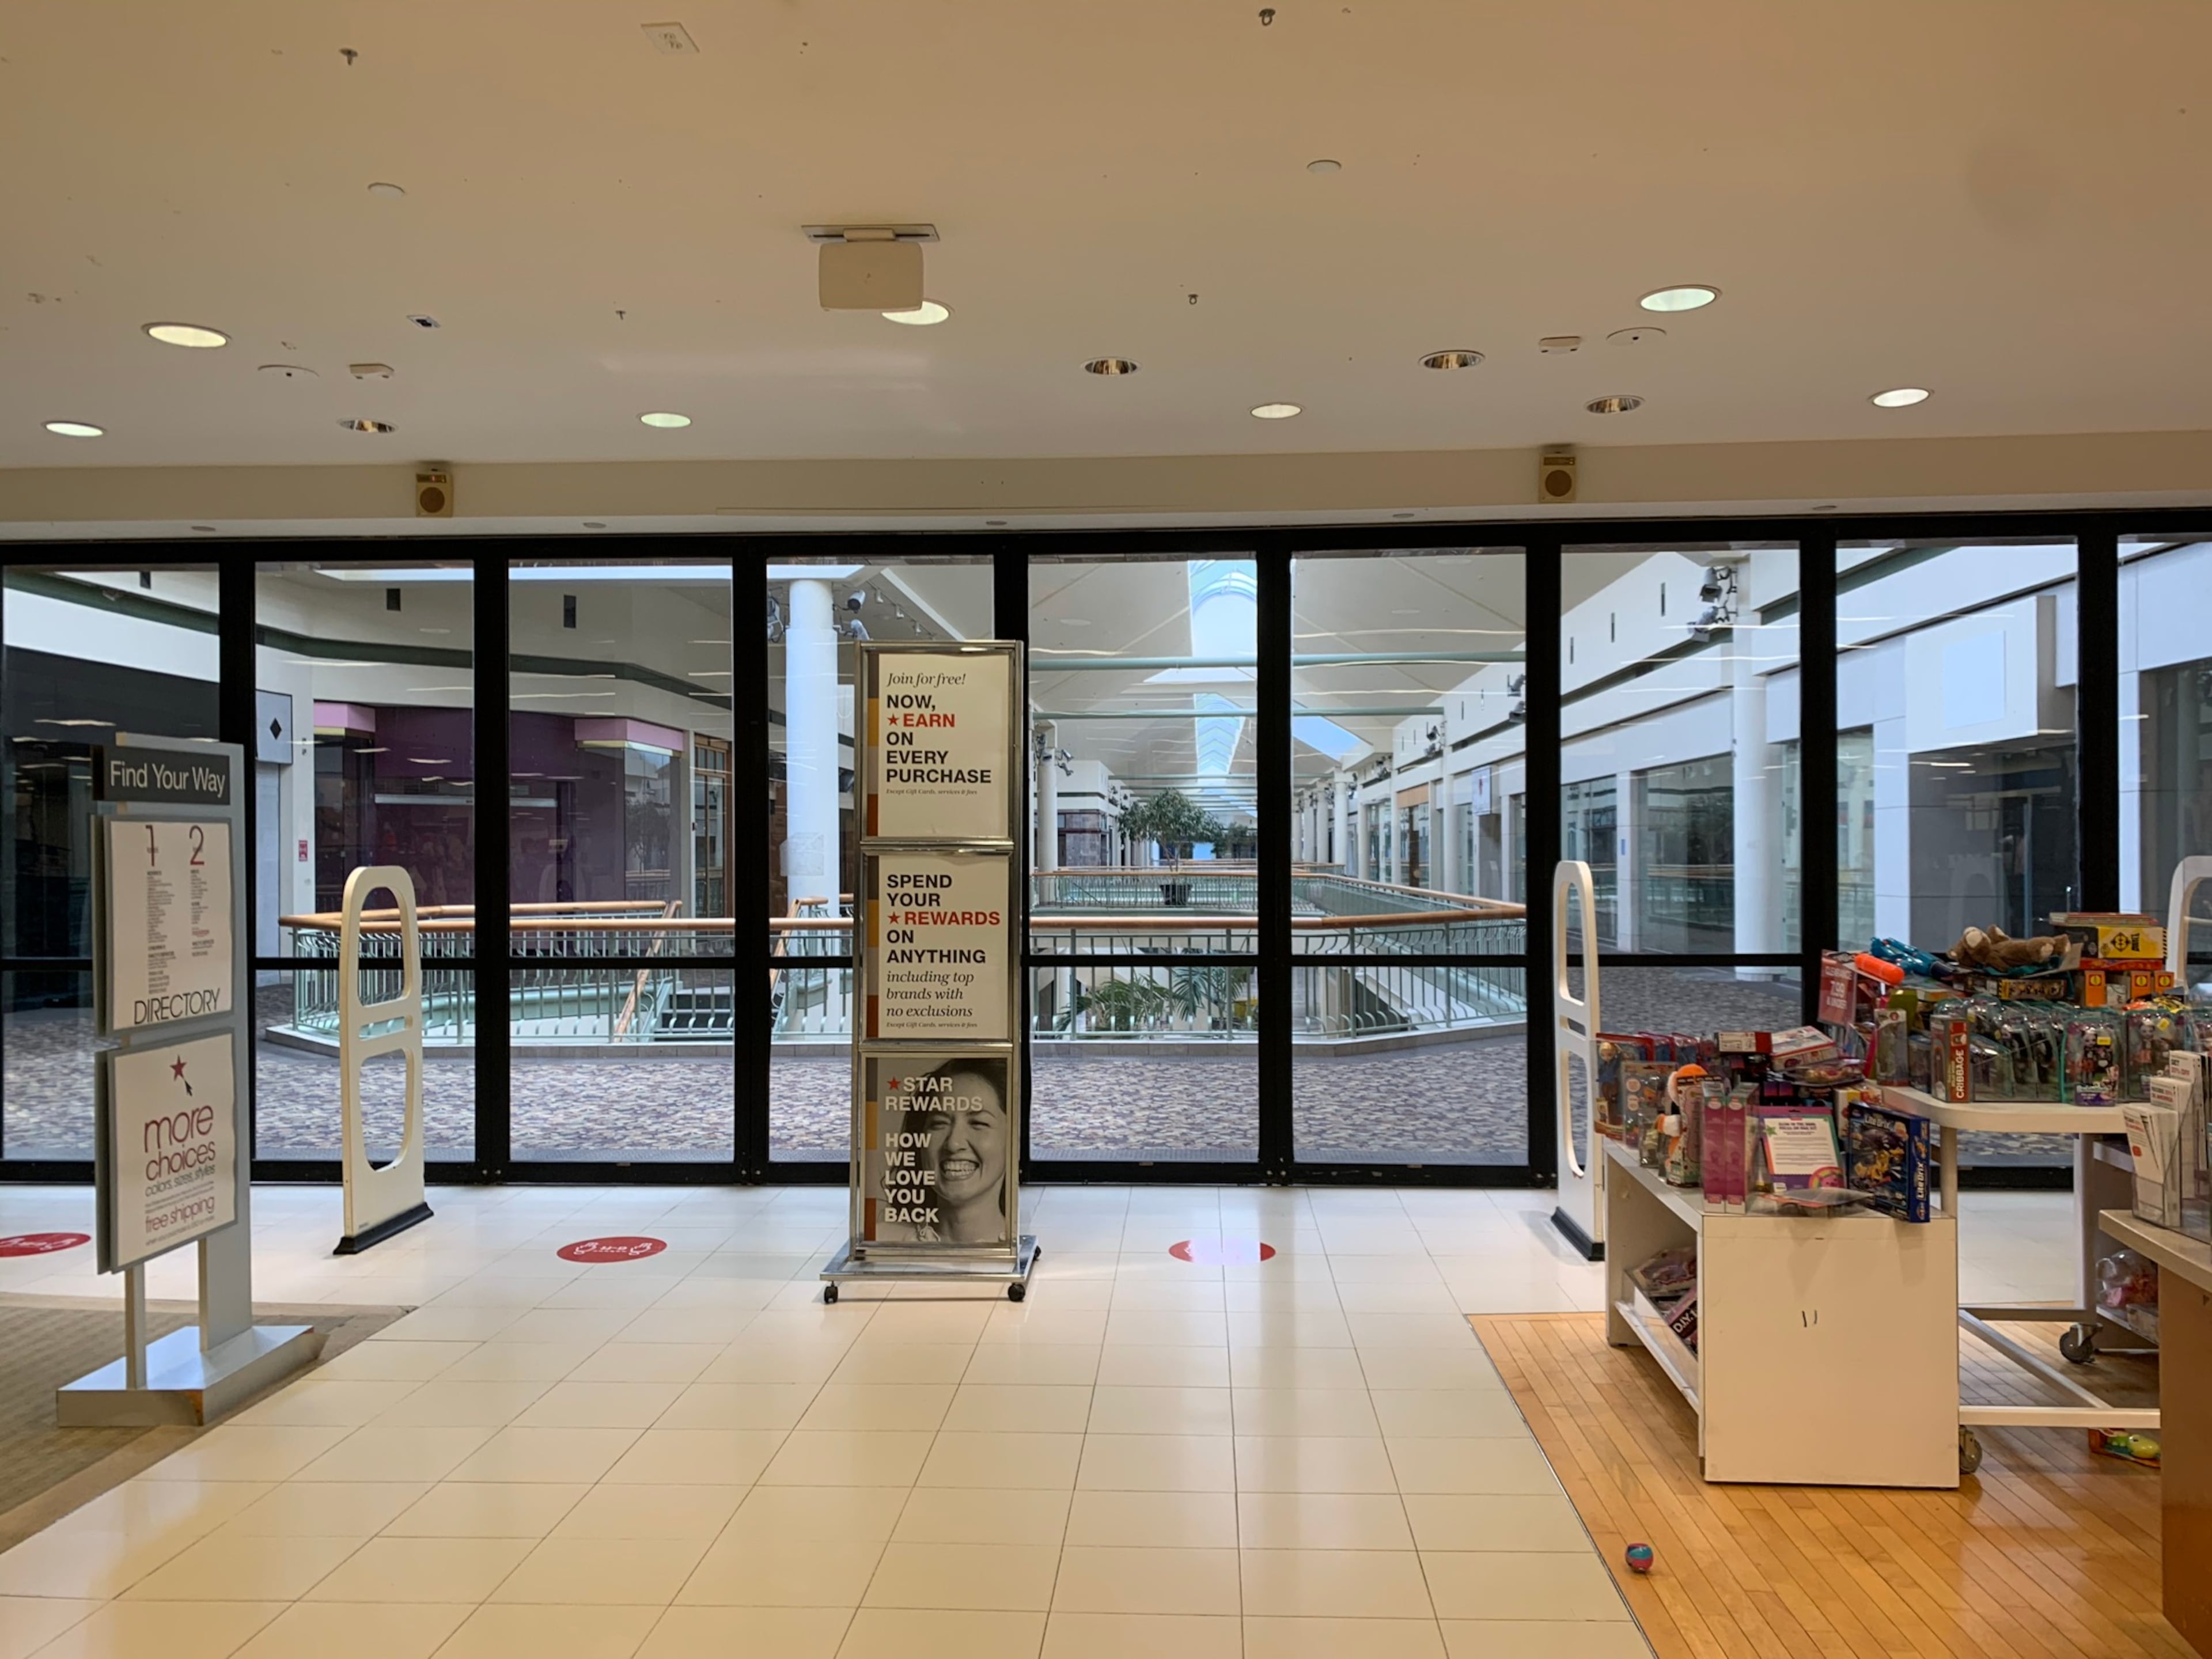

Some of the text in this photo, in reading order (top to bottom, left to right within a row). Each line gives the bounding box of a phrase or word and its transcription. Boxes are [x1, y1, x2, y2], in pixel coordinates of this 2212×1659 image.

[887, 672, 965, 688] Join for free!
[887, 695, 935, 711] NOW,
[903, 714, 955, 728] EARN
[887, 732, 913, 745] ON
[887, 750, 949, 764] EVERY
[110, 760, 225, 798] Find Your Way
[886, 769, 991, 783] PURCHASE
[145, 824, 155, 867] 1
[189, 825, 204, 865] 2
[887, 874, 952, 888] SPEND
[887, 893, 941, 907] YOUR
[904, 911, 1001, 925] REWARDS
[887, 930, 914, 944] ON
[887, 949, 986, 964] ANYTHING
[887, 971, 974, 987] including top
[887, 988, 963, 1000] brands with
[134, 987, 221, 1025] DIRECTORY
[887, 1005, 973, 1017] no exclusions
[1955, 1049, 1964, 1099] CRIBBAGE
[903, 1077, 953, 1092] STAR
[885, 1096, 983, 1111] REWARDS
[144, 1105, 214, 1153] more
[885, 1132, 931, 1148] HOW
[146, 1141, 216, 1181] choices
[885, 1152, 916, 1166] WE
[195, 1164, 215, 1180] styles
[884, 1170, 935, 1185] LOVE
[1916, 1161, 1925, 1180] Brix
[884, 1189, 925, 1204] YOU
[1916, 1181, 1925, 1199] Lite
[145, 1214, 168, 1233] free
[170, 1196, 215, 1224] shipping
[884, 1207, 940, 1223] BACK
[1673, 1312, 1694, 1333] D.I.Y.
